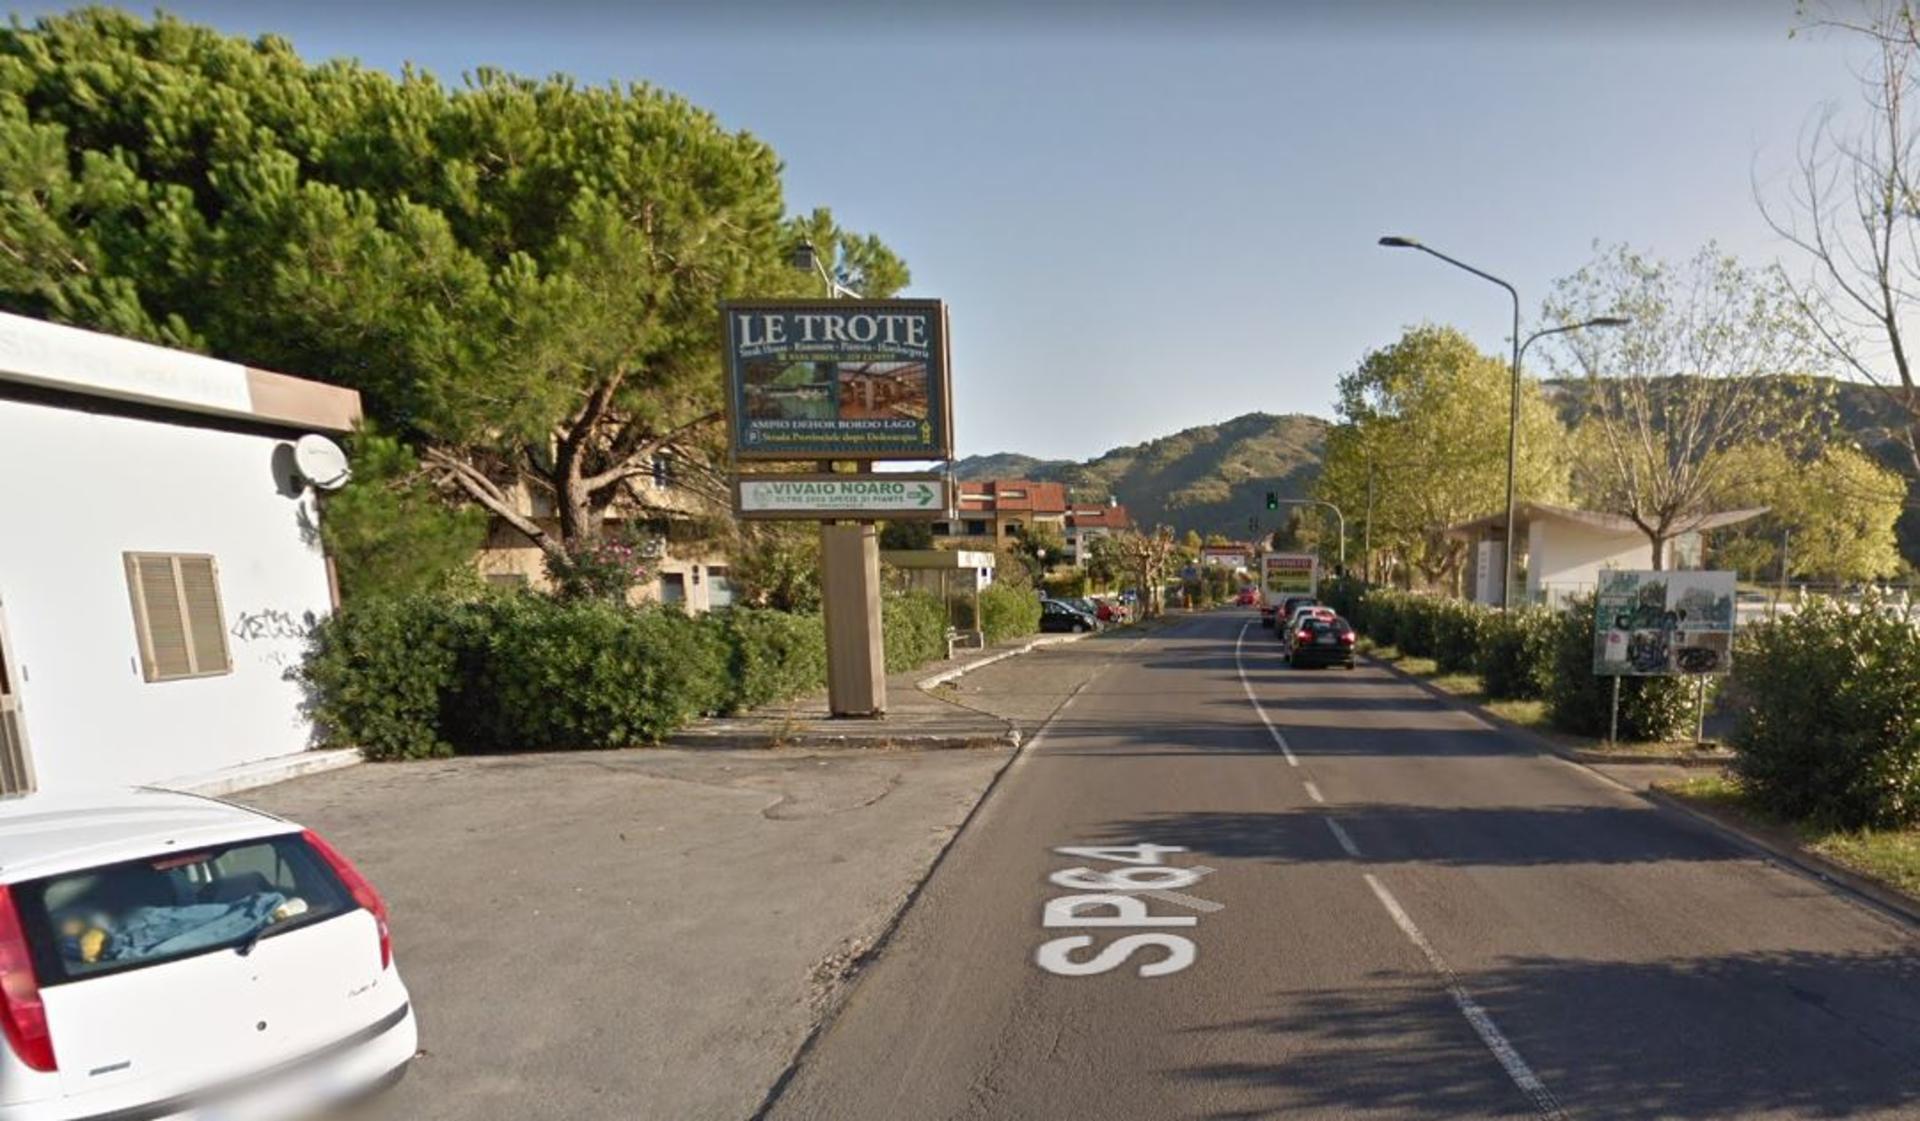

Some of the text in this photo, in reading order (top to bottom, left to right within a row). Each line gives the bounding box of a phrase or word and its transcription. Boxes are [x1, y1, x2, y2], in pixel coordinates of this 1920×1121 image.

[738, 315, 928, 347] LE TROTE
[751, 420, 916, 429] AMPIO DEHOR BORDO LAGO
[773, 483, 905, 494] VIVAIO NOARO
